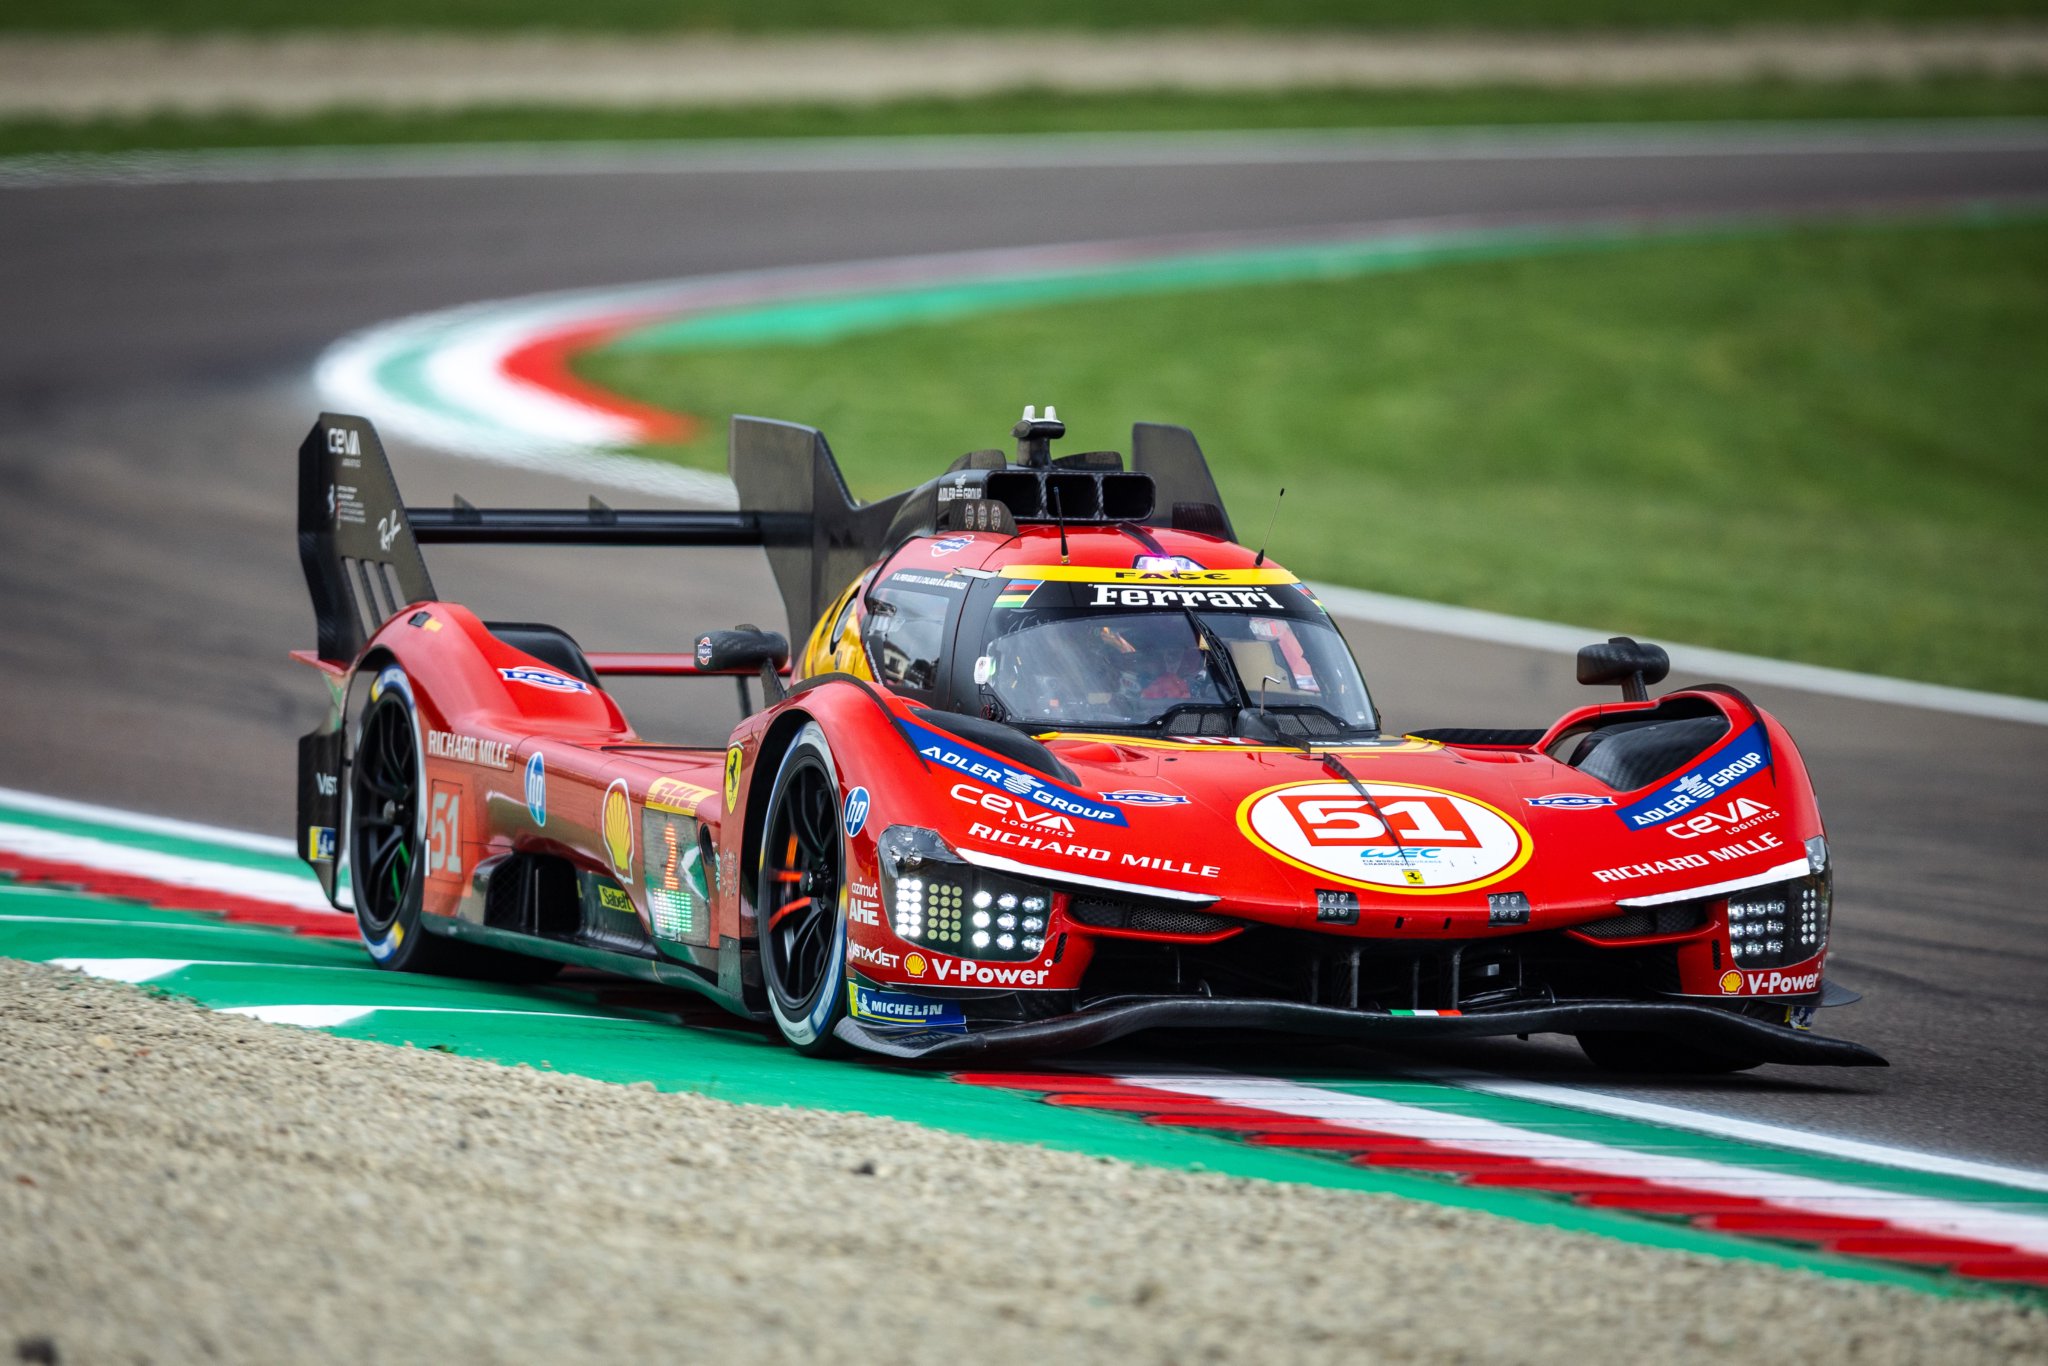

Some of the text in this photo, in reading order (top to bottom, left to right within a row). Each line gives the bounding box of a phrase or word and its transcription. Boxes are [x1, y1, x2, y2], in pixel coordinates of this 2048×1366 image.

[1090, 584, 1284, 609] Ferrari
[428, 729, 513, 768] RICHARD MILLE
[528, 763, 545, 812] hp
[920, 746, 1116, 822] ADLER GROUP
[1632, 752, 1761, 825] ADLER GROUP
[431, 792, 463, 873] 51
[847, 795, 868, 834] hp
[1001, 816, 1075, 838] LOGISTICS
[1298, 800, 1467, 841] 51
[1725, 810, 1780, 835] LOGISTICS
[968, 822, 1221, 878] RICHARD MILLE
[1592, 832, 1783, 883] RICHARD MILLE
[852, 876, 878, 898] azimut
[931, 958, 1049, 985] V-Power
[1747, 972, 1819, 994] V-Power
[871, 1000, 944, 1016] MICHELIN
